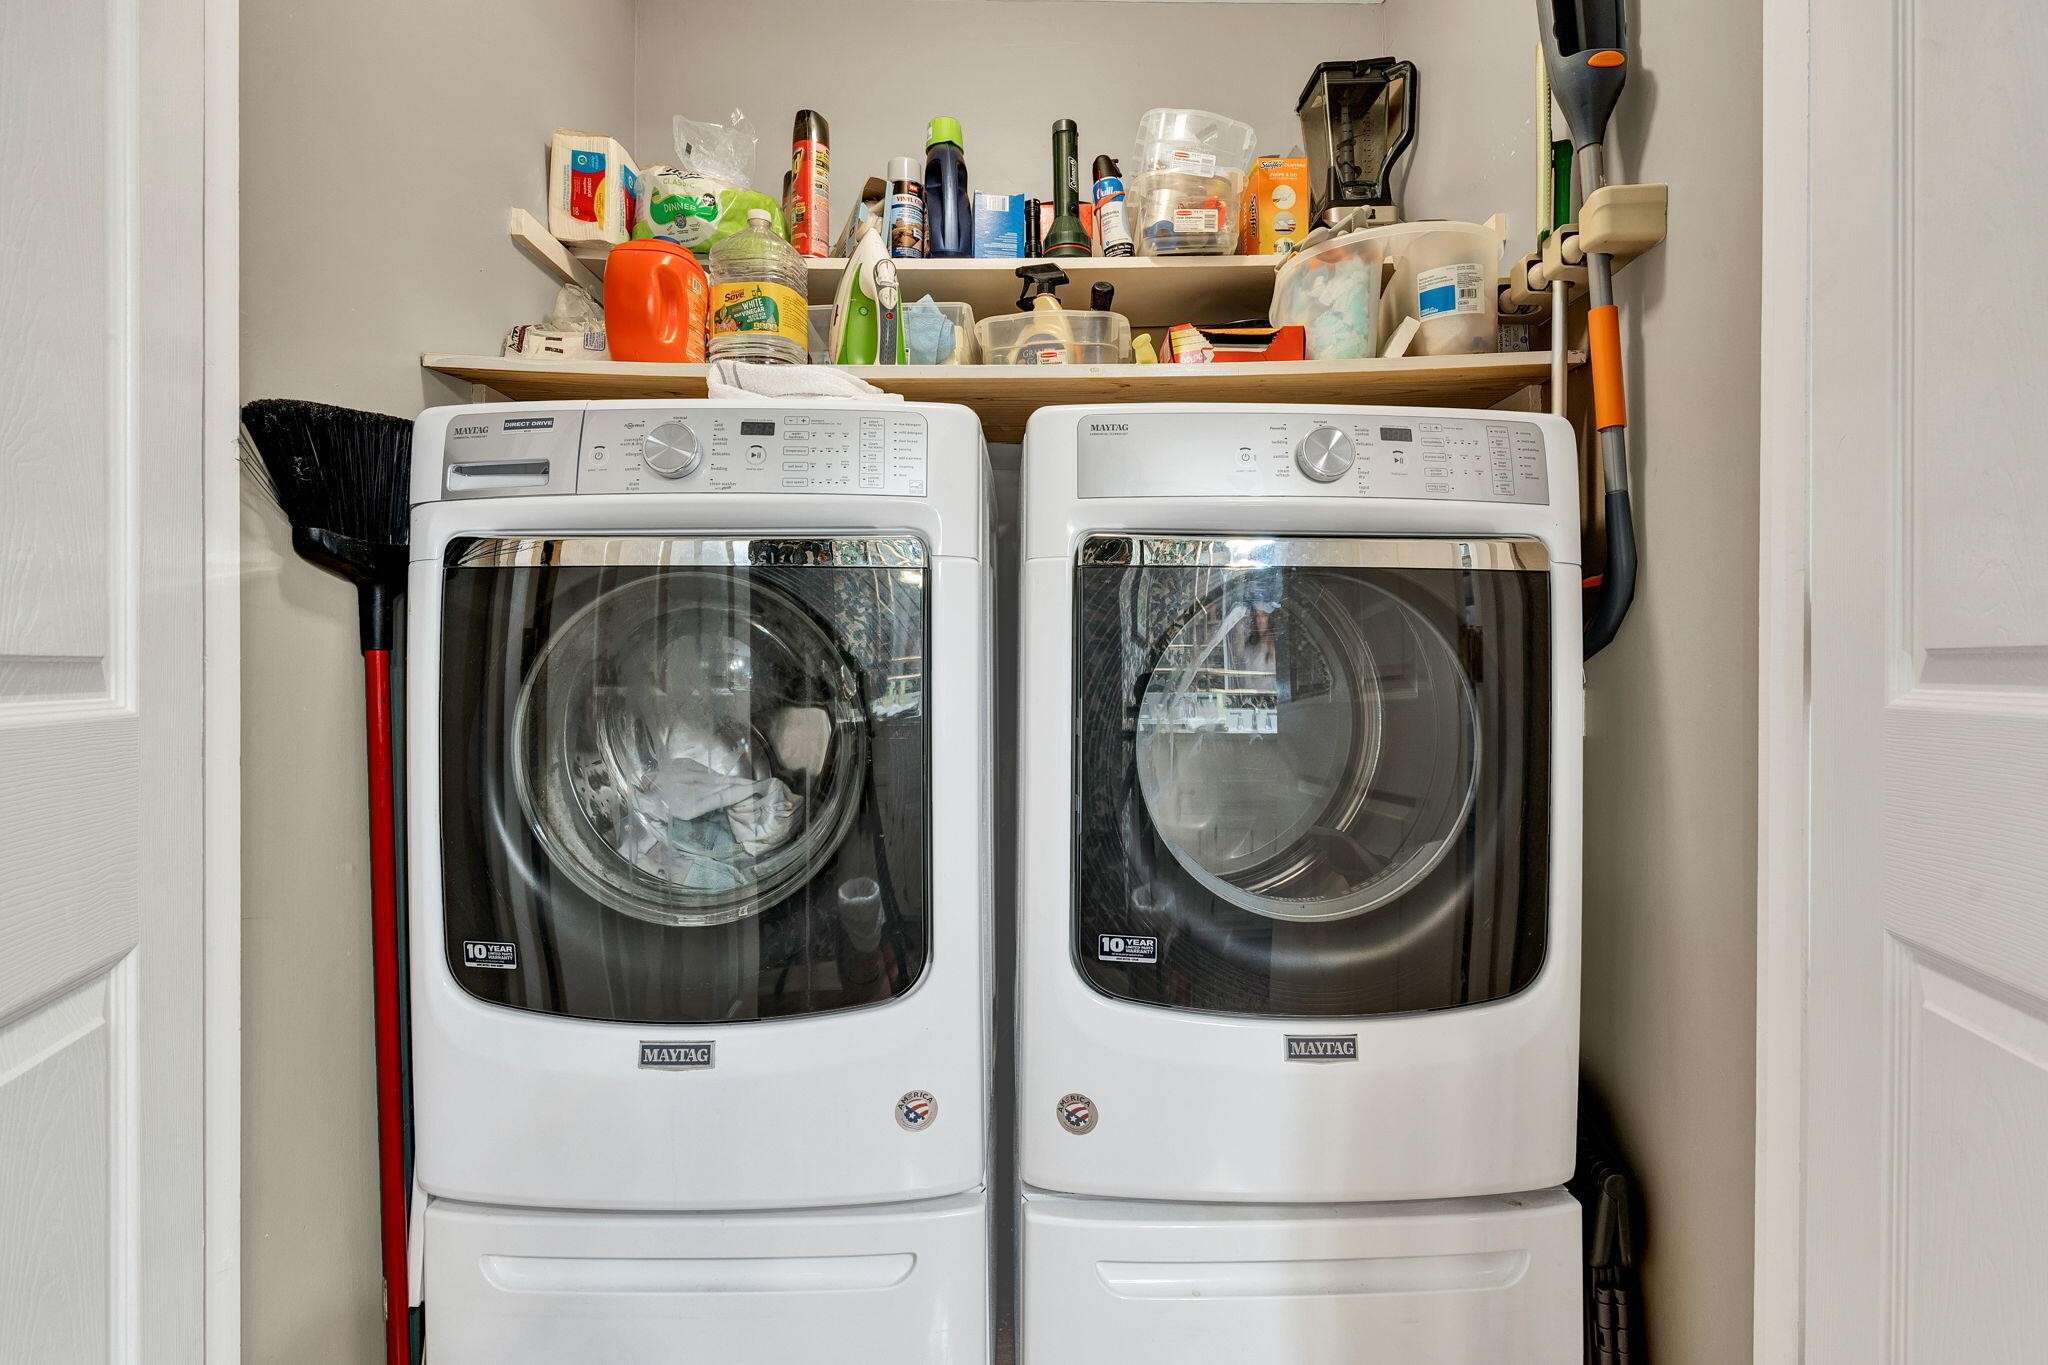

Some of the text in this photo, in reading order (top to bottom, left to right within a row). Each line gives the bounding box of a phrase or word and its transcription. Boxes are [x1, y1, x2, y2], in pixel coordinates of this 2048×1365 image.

[663, 178, 695, 189] CLASSIC
[663, 201, 697, 213] DINNER
[725, 291, 745, 302] Save
[742, 297, 764, 310] WHITE
[741, 306, 765, 317] VINEGAR
[505, 420, 530, 428] DIRECT
[1090, 424, 1129, 432] MAYTAG
[454, 426, 489, 436] MAYTAG
[1102, 937, 1154, 952] 10 YEAR
[467, 943, 487, 959] 10
[1290, 1041, 1354, 1055] MAYTAG
[643, 1048, 709, 1062] MAYTAG
[898, 1091, 933, 1110] AMERICA
[1058, 1095, 1091, 1112] AMERICA
